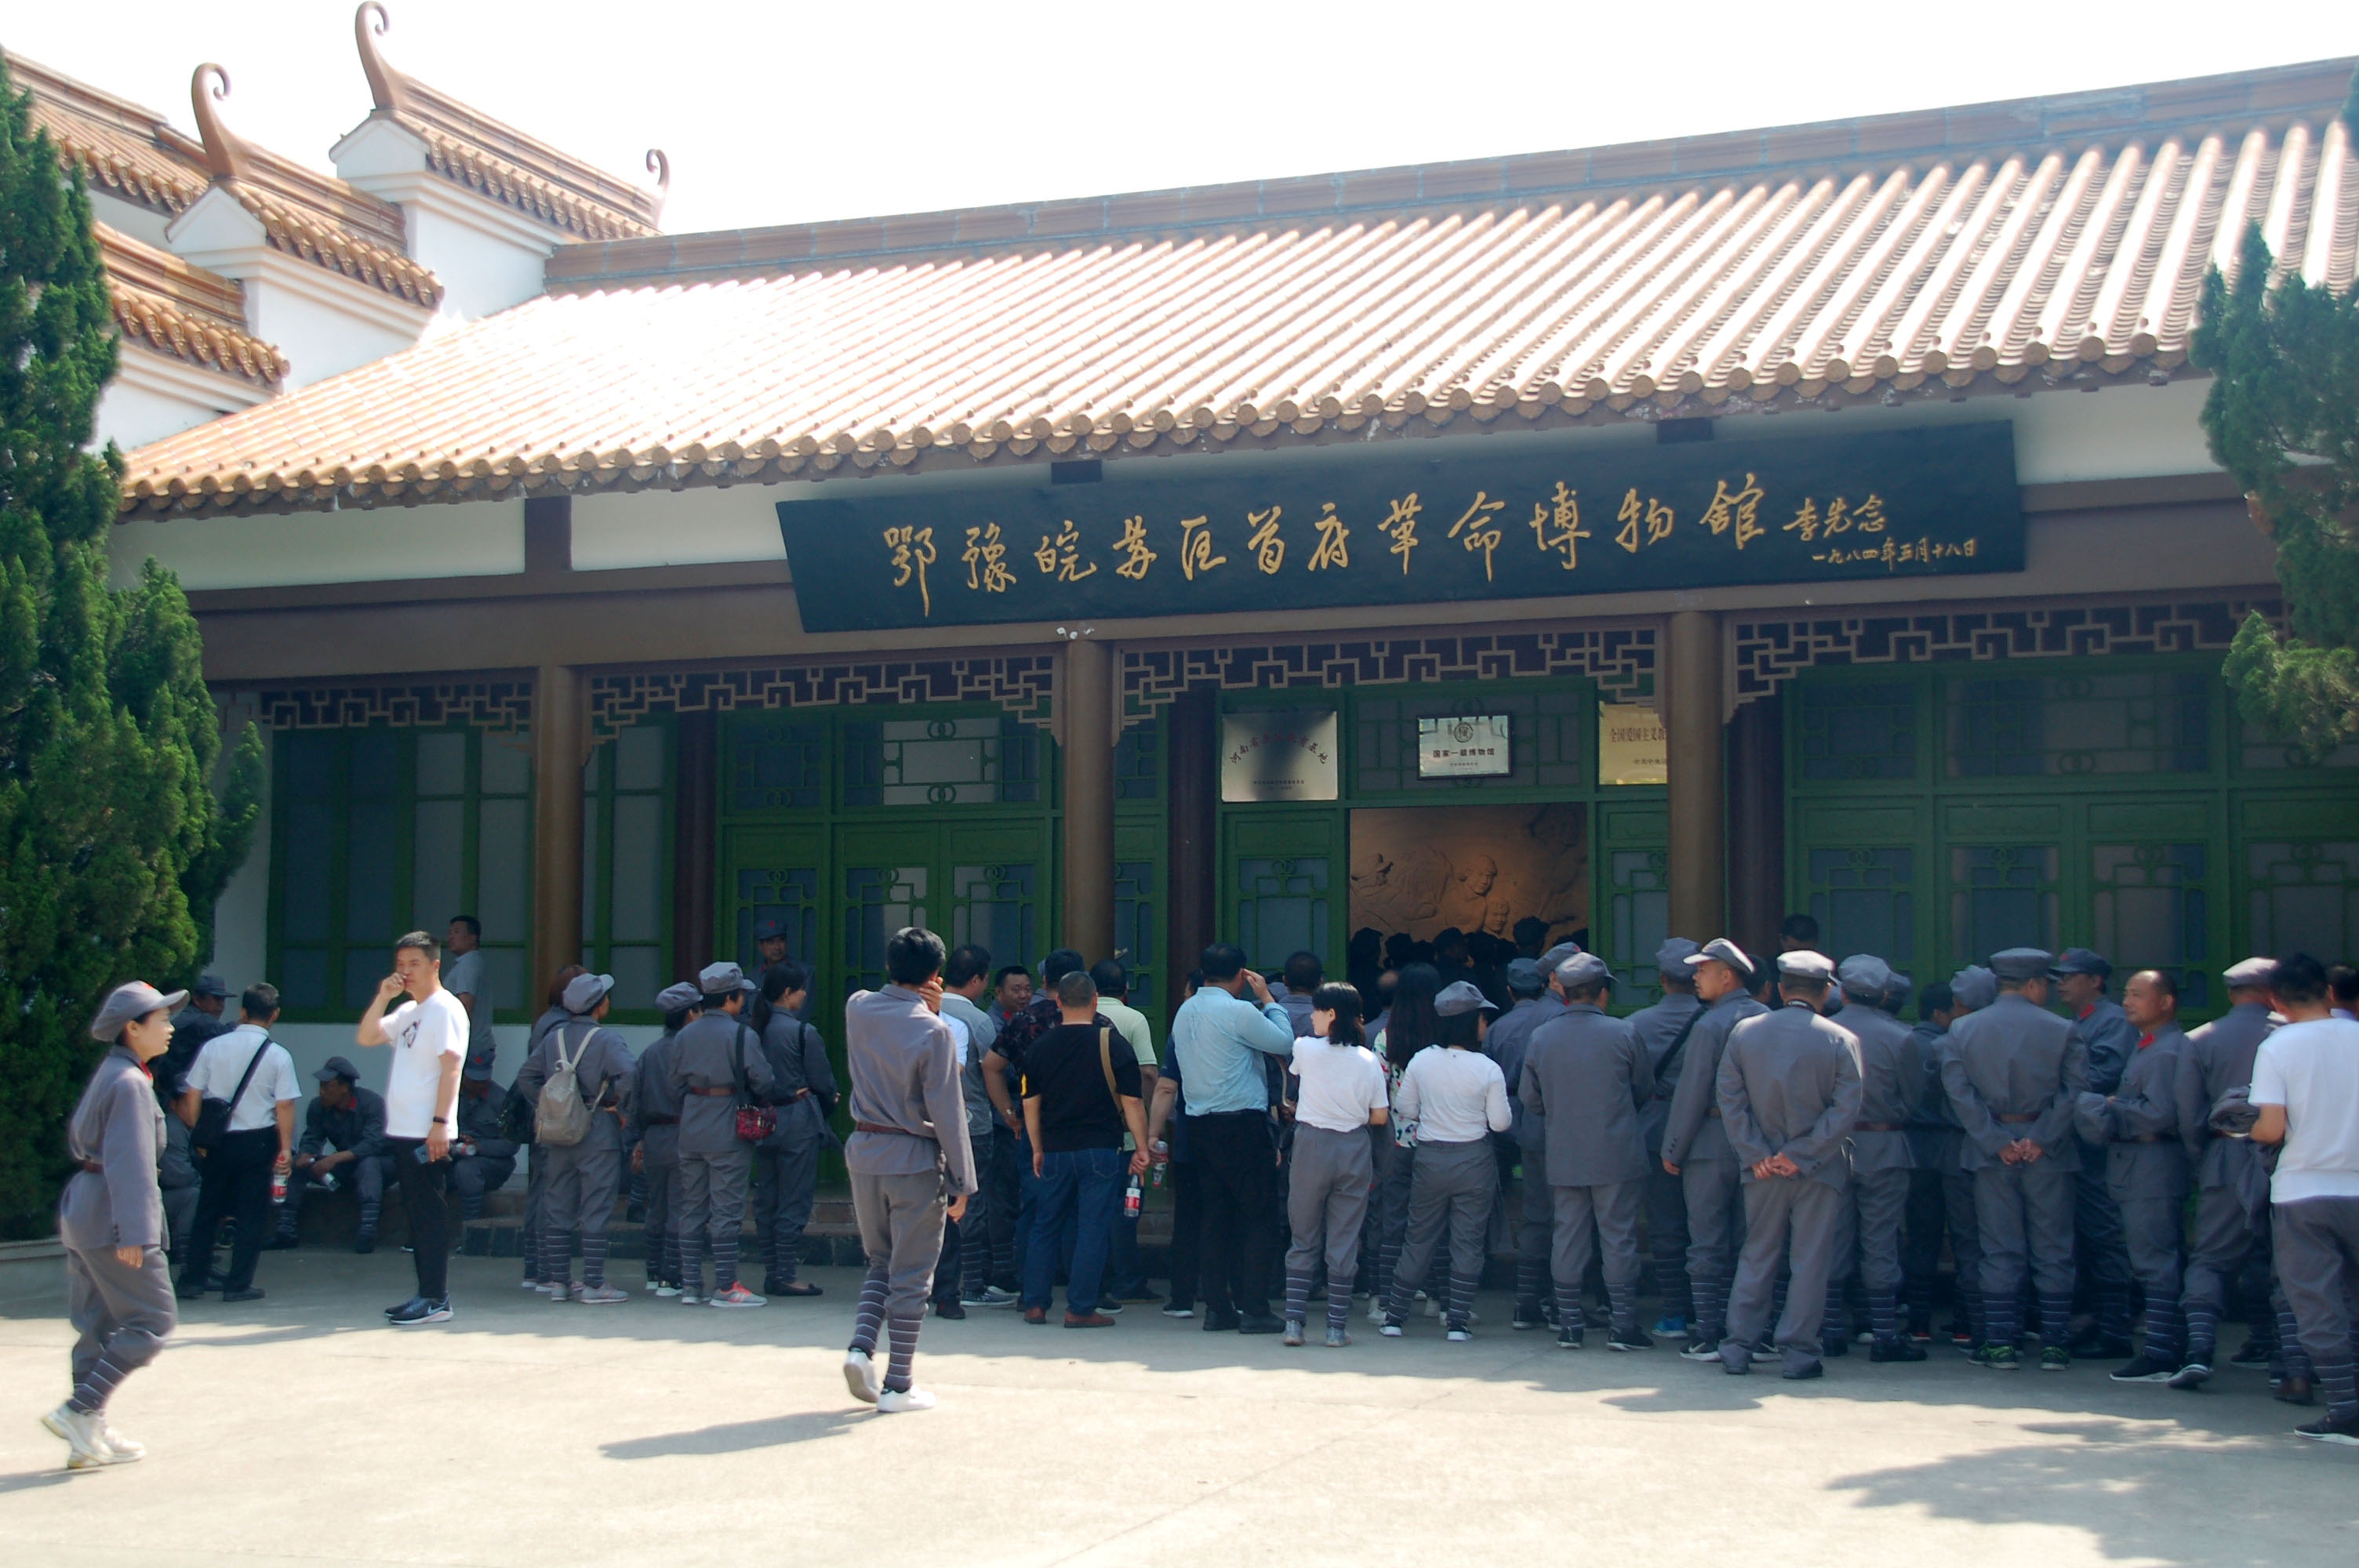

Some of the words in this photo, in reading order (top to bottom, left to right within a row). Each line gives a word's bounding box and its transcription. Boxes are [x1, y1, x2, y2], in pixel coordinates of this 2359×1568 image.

[1782, 494, 1885, 541] 李先念
[1812, 536, 1977, 572] 一九八四年五月十八日
[1433, 747, 1495, 758] 国家一级博物馆
